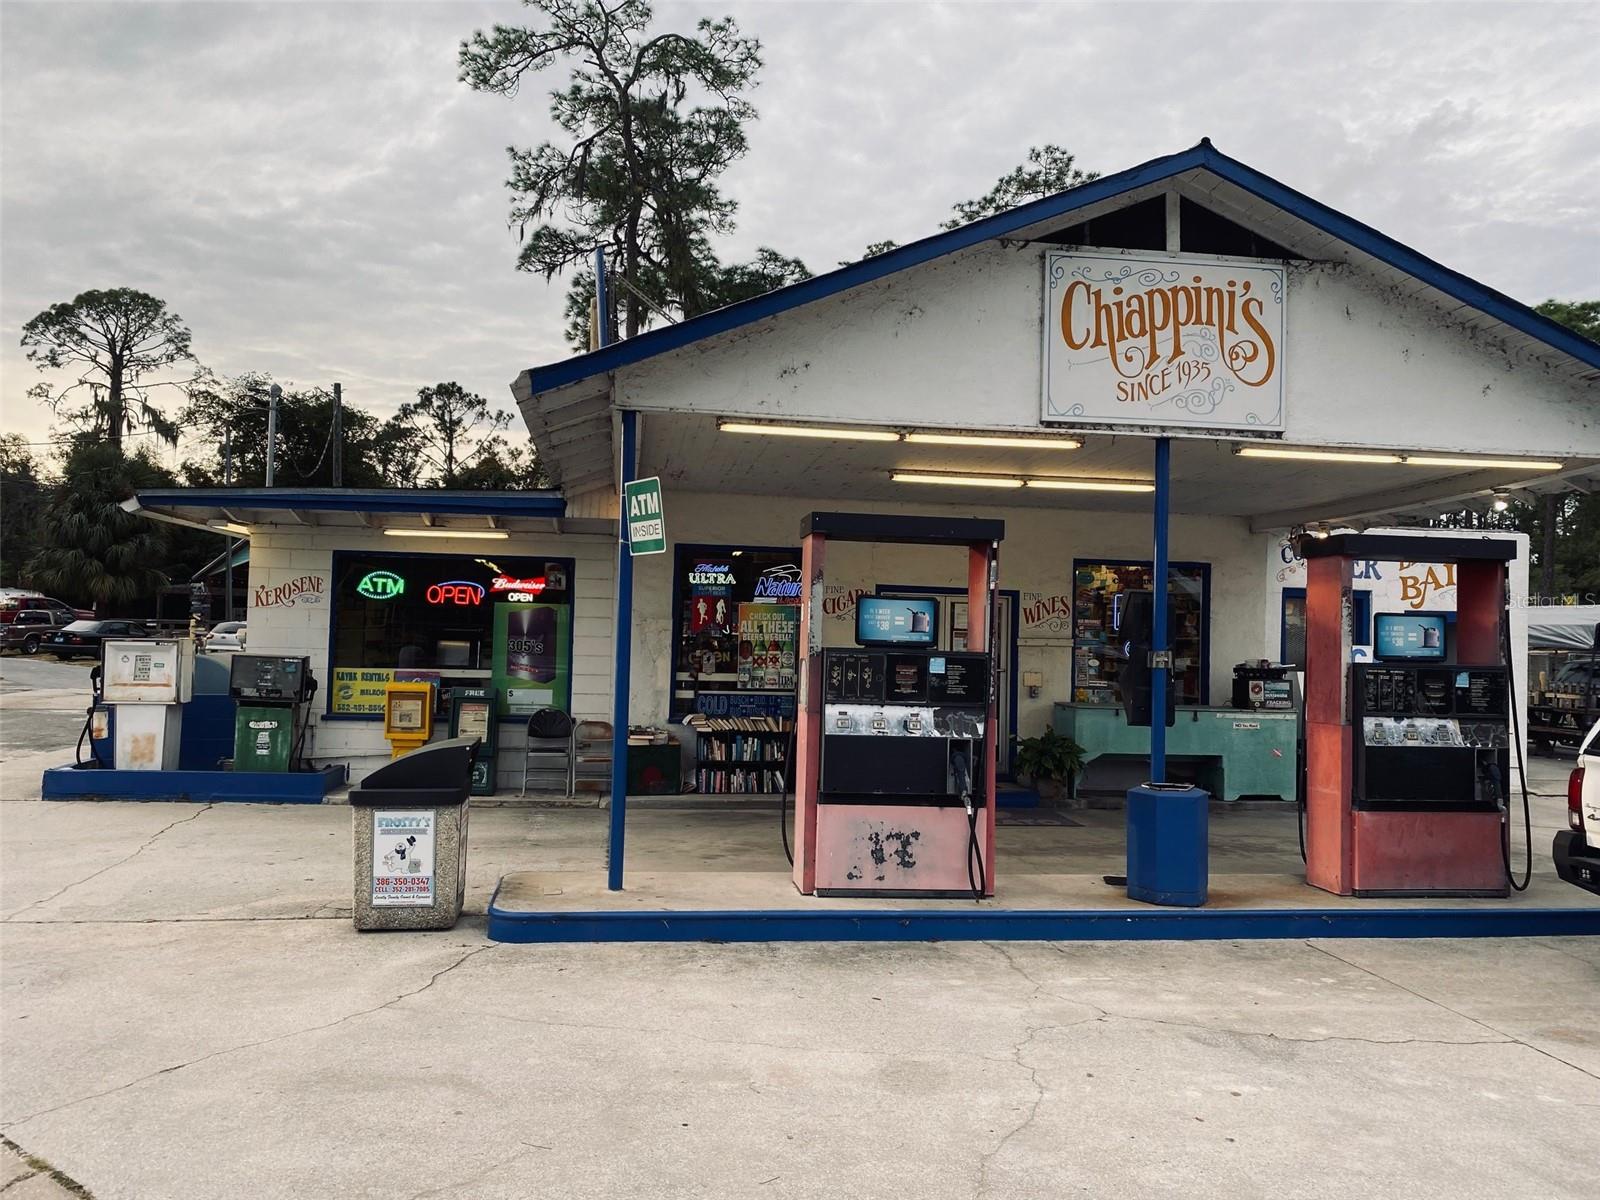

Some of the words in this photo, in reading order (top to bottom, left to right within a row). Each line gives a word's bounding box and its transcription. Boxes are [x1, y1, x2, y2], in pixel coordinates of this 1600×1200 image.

[1061, 275, 1275, 387] Chiappini's
[1116, 366, 1172, 402] SINCE
[1176, 359, 1212, 389] 1935
[630, 491, 660, 518] ATM
[632, 523, 660, 538] INSIDE
[1352, 560, 1382, 581] ER
[356, 577, 405, 594] ATM
[492, 577, 546, 591] Budweiser
[688, 572, 737, 585] ULTRA
[255, 575, 325, 608] KEROSENE
[824, 585, 844, 594] FINE
[1399, 563, 1456, 610] BAI
[427, 585, 482, 605] OPEN
[508, 592, 533, 602] OPEN
[1023, 592, 1042, 601] FINE
[749, 612, 771, 620] CHECK
[1022, 595, 1071, 624] WINES
[741, 620, 758, 633] ALL
[761, 620, 794, 633] THESE
[743, 632, 764, 640] BEERS
[509, 639, 544, 654] 305's
[336, 671, 357, 681] KAYAK
[360, 671, 390, 682] RENTALS
[464, 689, 485, 697] FREE
[697, 695, 728, 715] COLD
[377, 816, 431, 828] FROSTY'S
[376, 877, 430, 886] 386-350-0347
